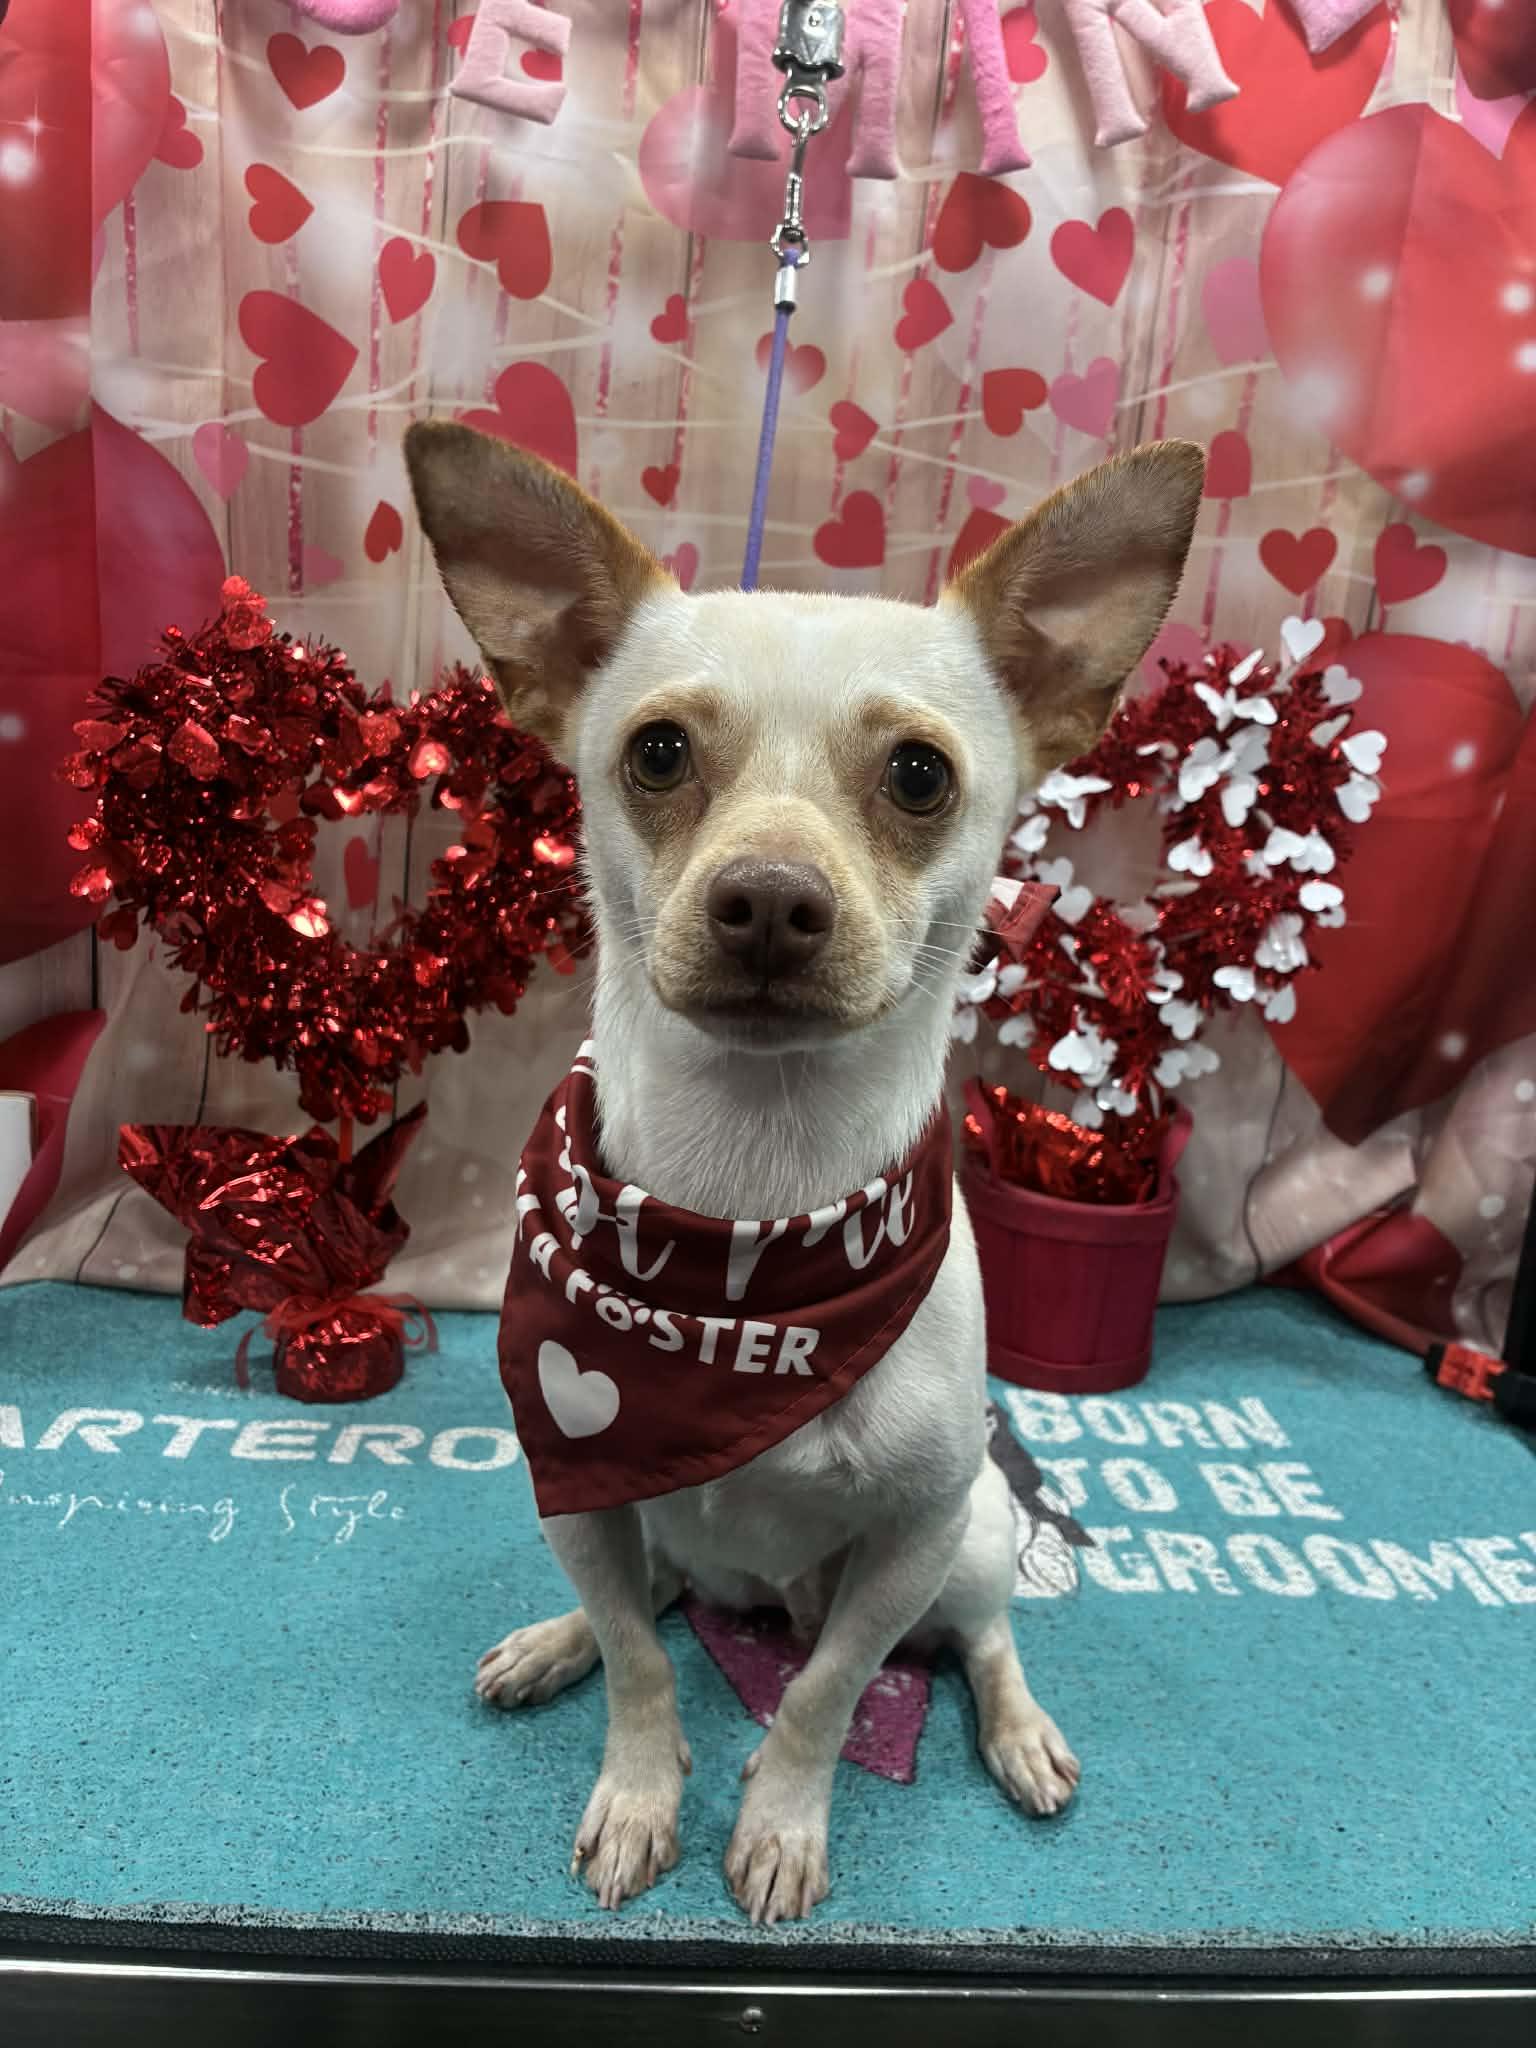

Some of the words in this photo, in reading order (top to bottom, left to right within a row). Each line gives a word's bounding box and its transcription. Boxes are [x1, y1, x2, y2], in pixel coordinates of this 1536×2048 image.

[0, 1404, 519, 1471] RTERO
[1004, 1389, 1291, 1449] BORN
[0, 1469, 240, 1542] nspiring
[1035, 1457, 1179, 1513] TO
[1199, 1462, 1343, 1521] BE
[1080, 1525, 1536, 1606] GROOME
